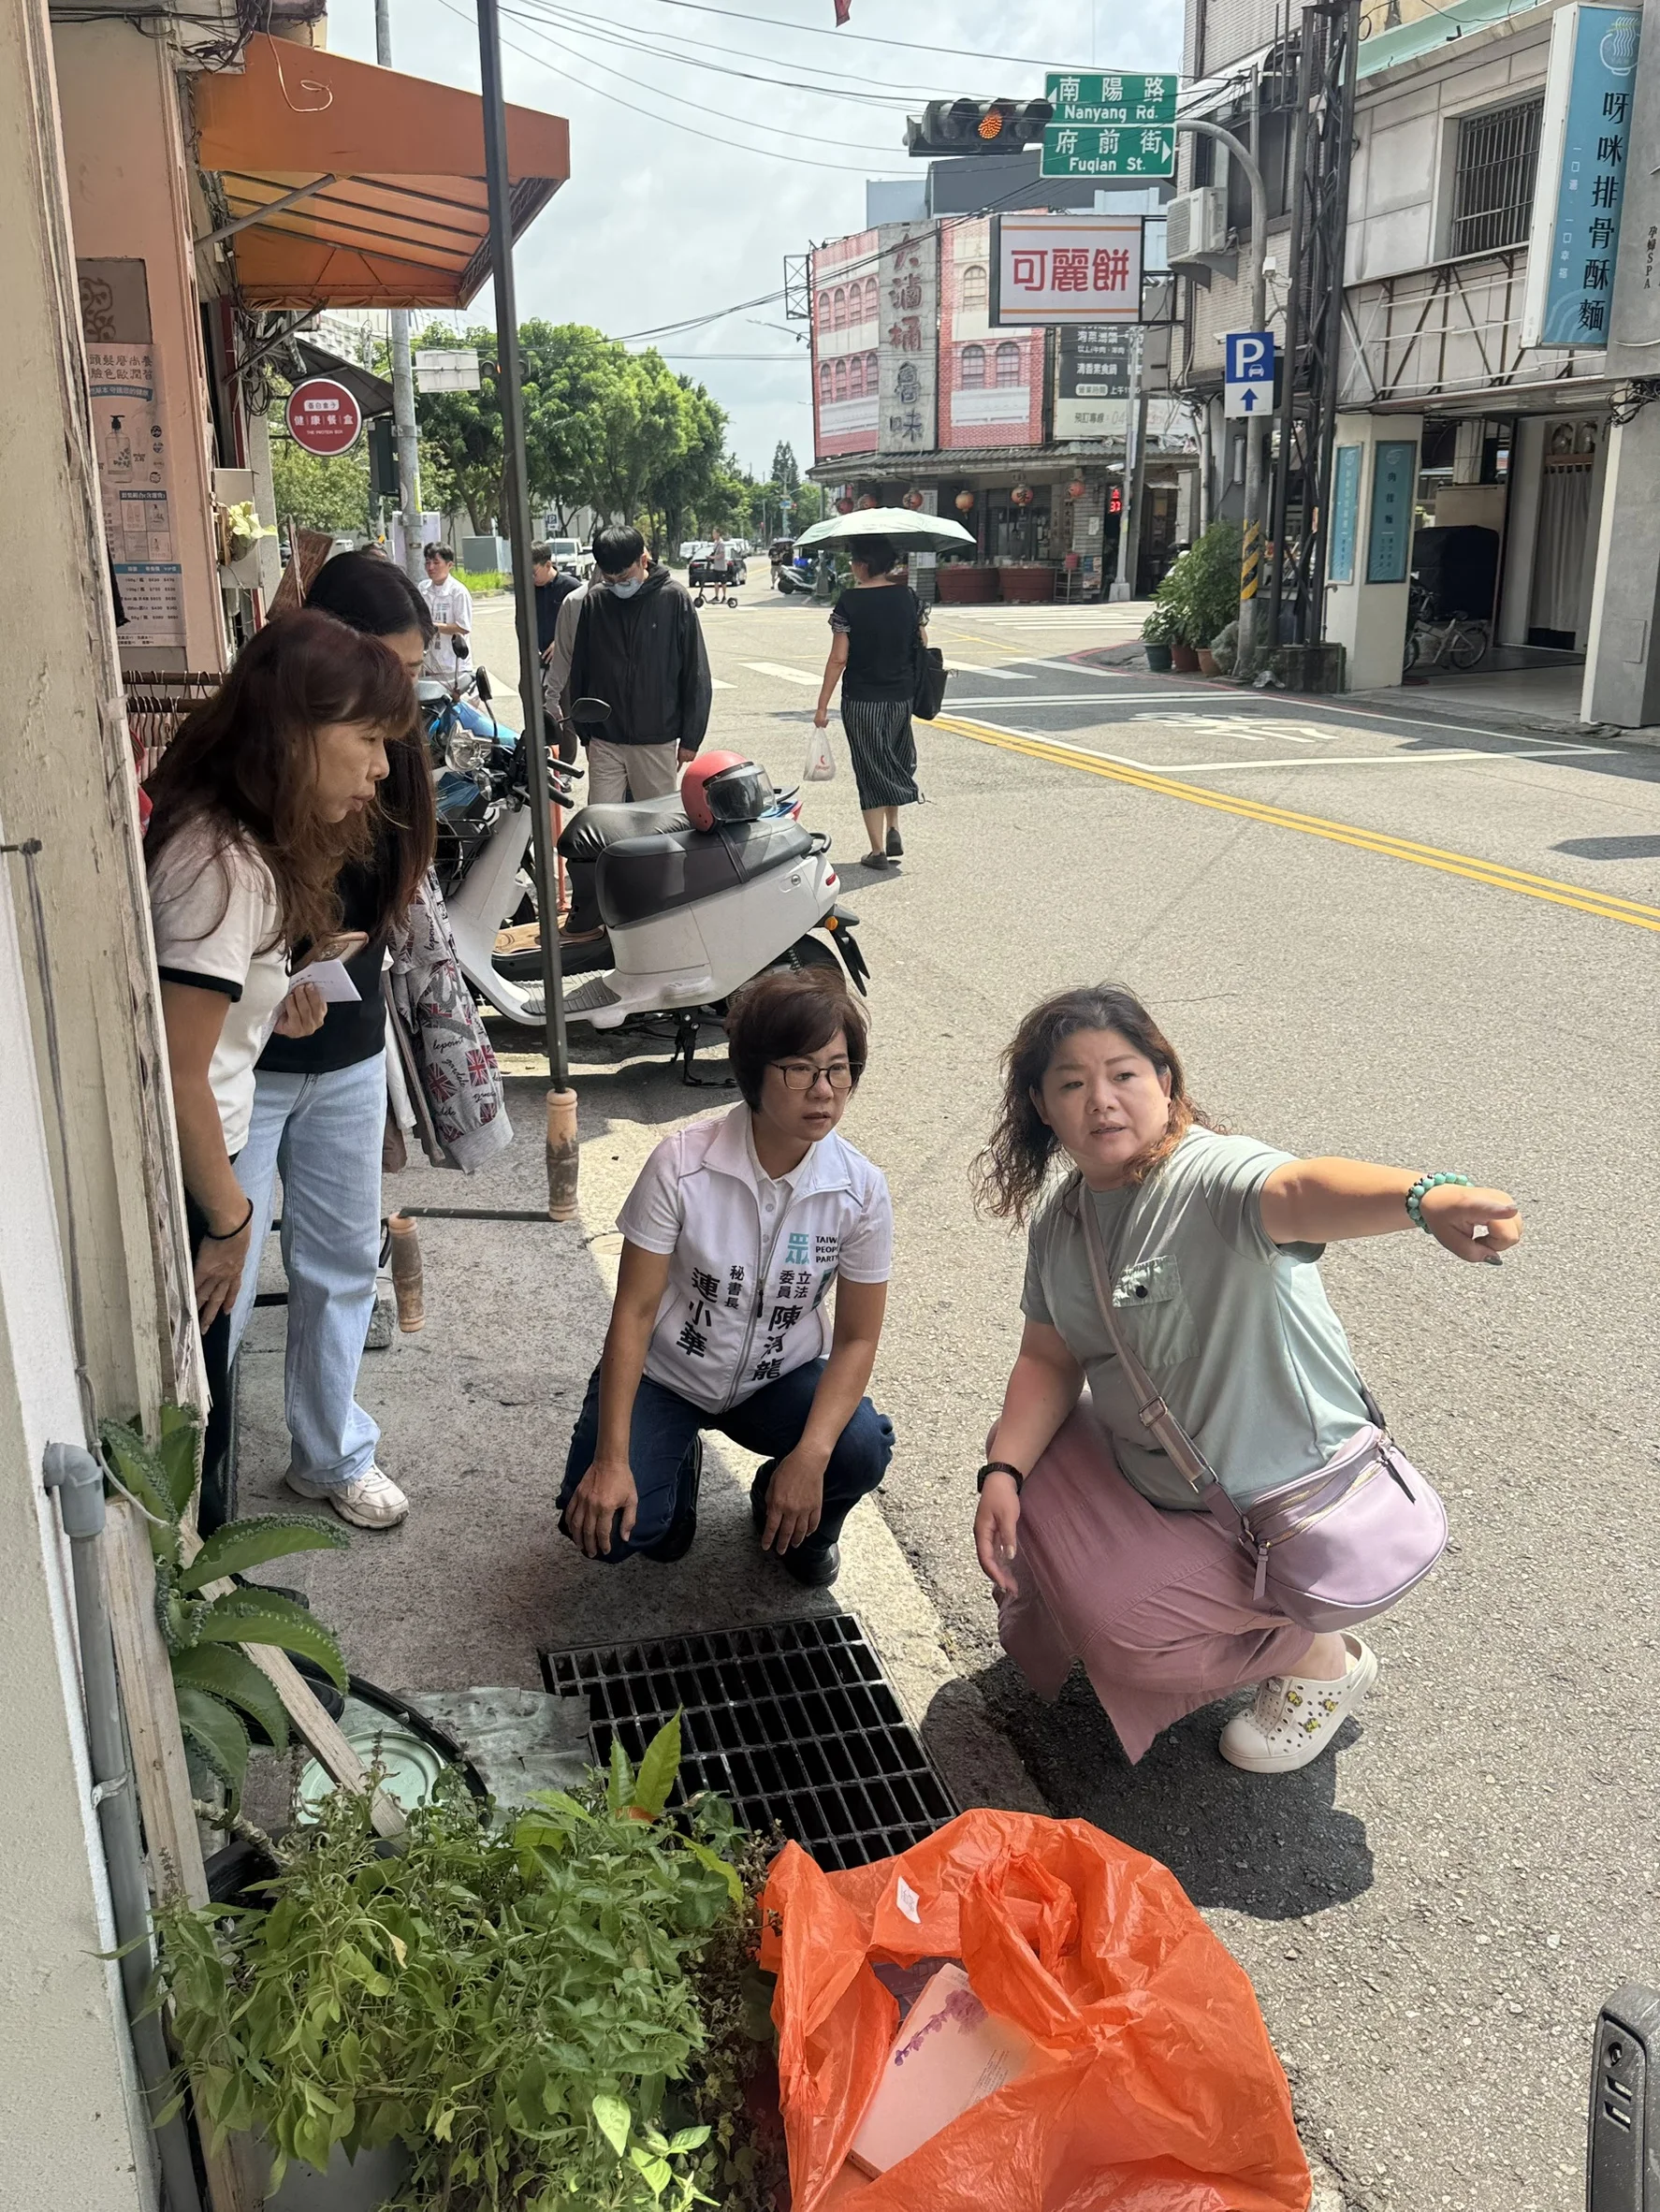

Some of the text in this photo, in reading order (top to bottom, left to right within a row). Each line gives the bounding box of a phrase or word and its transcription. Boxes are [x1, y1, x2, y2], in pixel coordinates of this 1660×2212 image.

[1059, 76, 1165, 103] 南陽路
[1064, 105, 1158, 123] Nanyang Rd.
[1055, 128, 1162, 155] 府前街
[1069, 157, 1146, 174] Fuqian St.
[1577, 91, 1630, 332] 呀咪排骨酥麵
[1011, 248, 1129, 292] 可麗餅
[1235, 338, 1265, 378] P
[723, 1265, 745, 1310] 秘書長
[676, 1267, 721, 1359] 連小華
